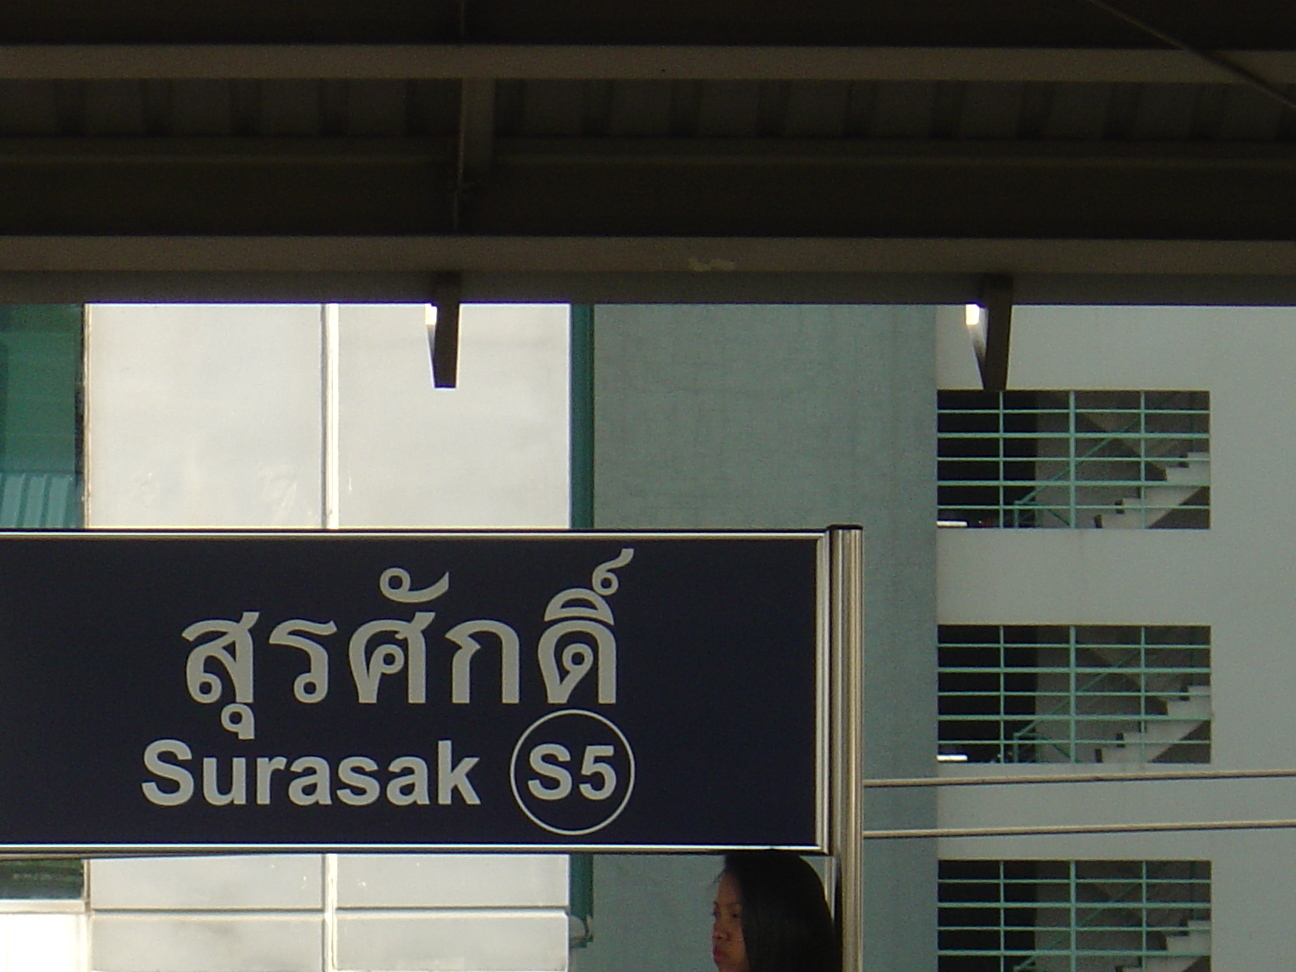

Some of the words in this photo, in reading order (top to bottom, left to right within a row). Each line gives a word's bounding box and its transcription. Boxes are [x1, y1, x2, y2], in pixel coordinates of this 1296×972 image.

[181, 548, 635, 740] สุรศักดิ์
[141, 738, 482, 806] Surasak
[527, 743, 618, 801] S5
